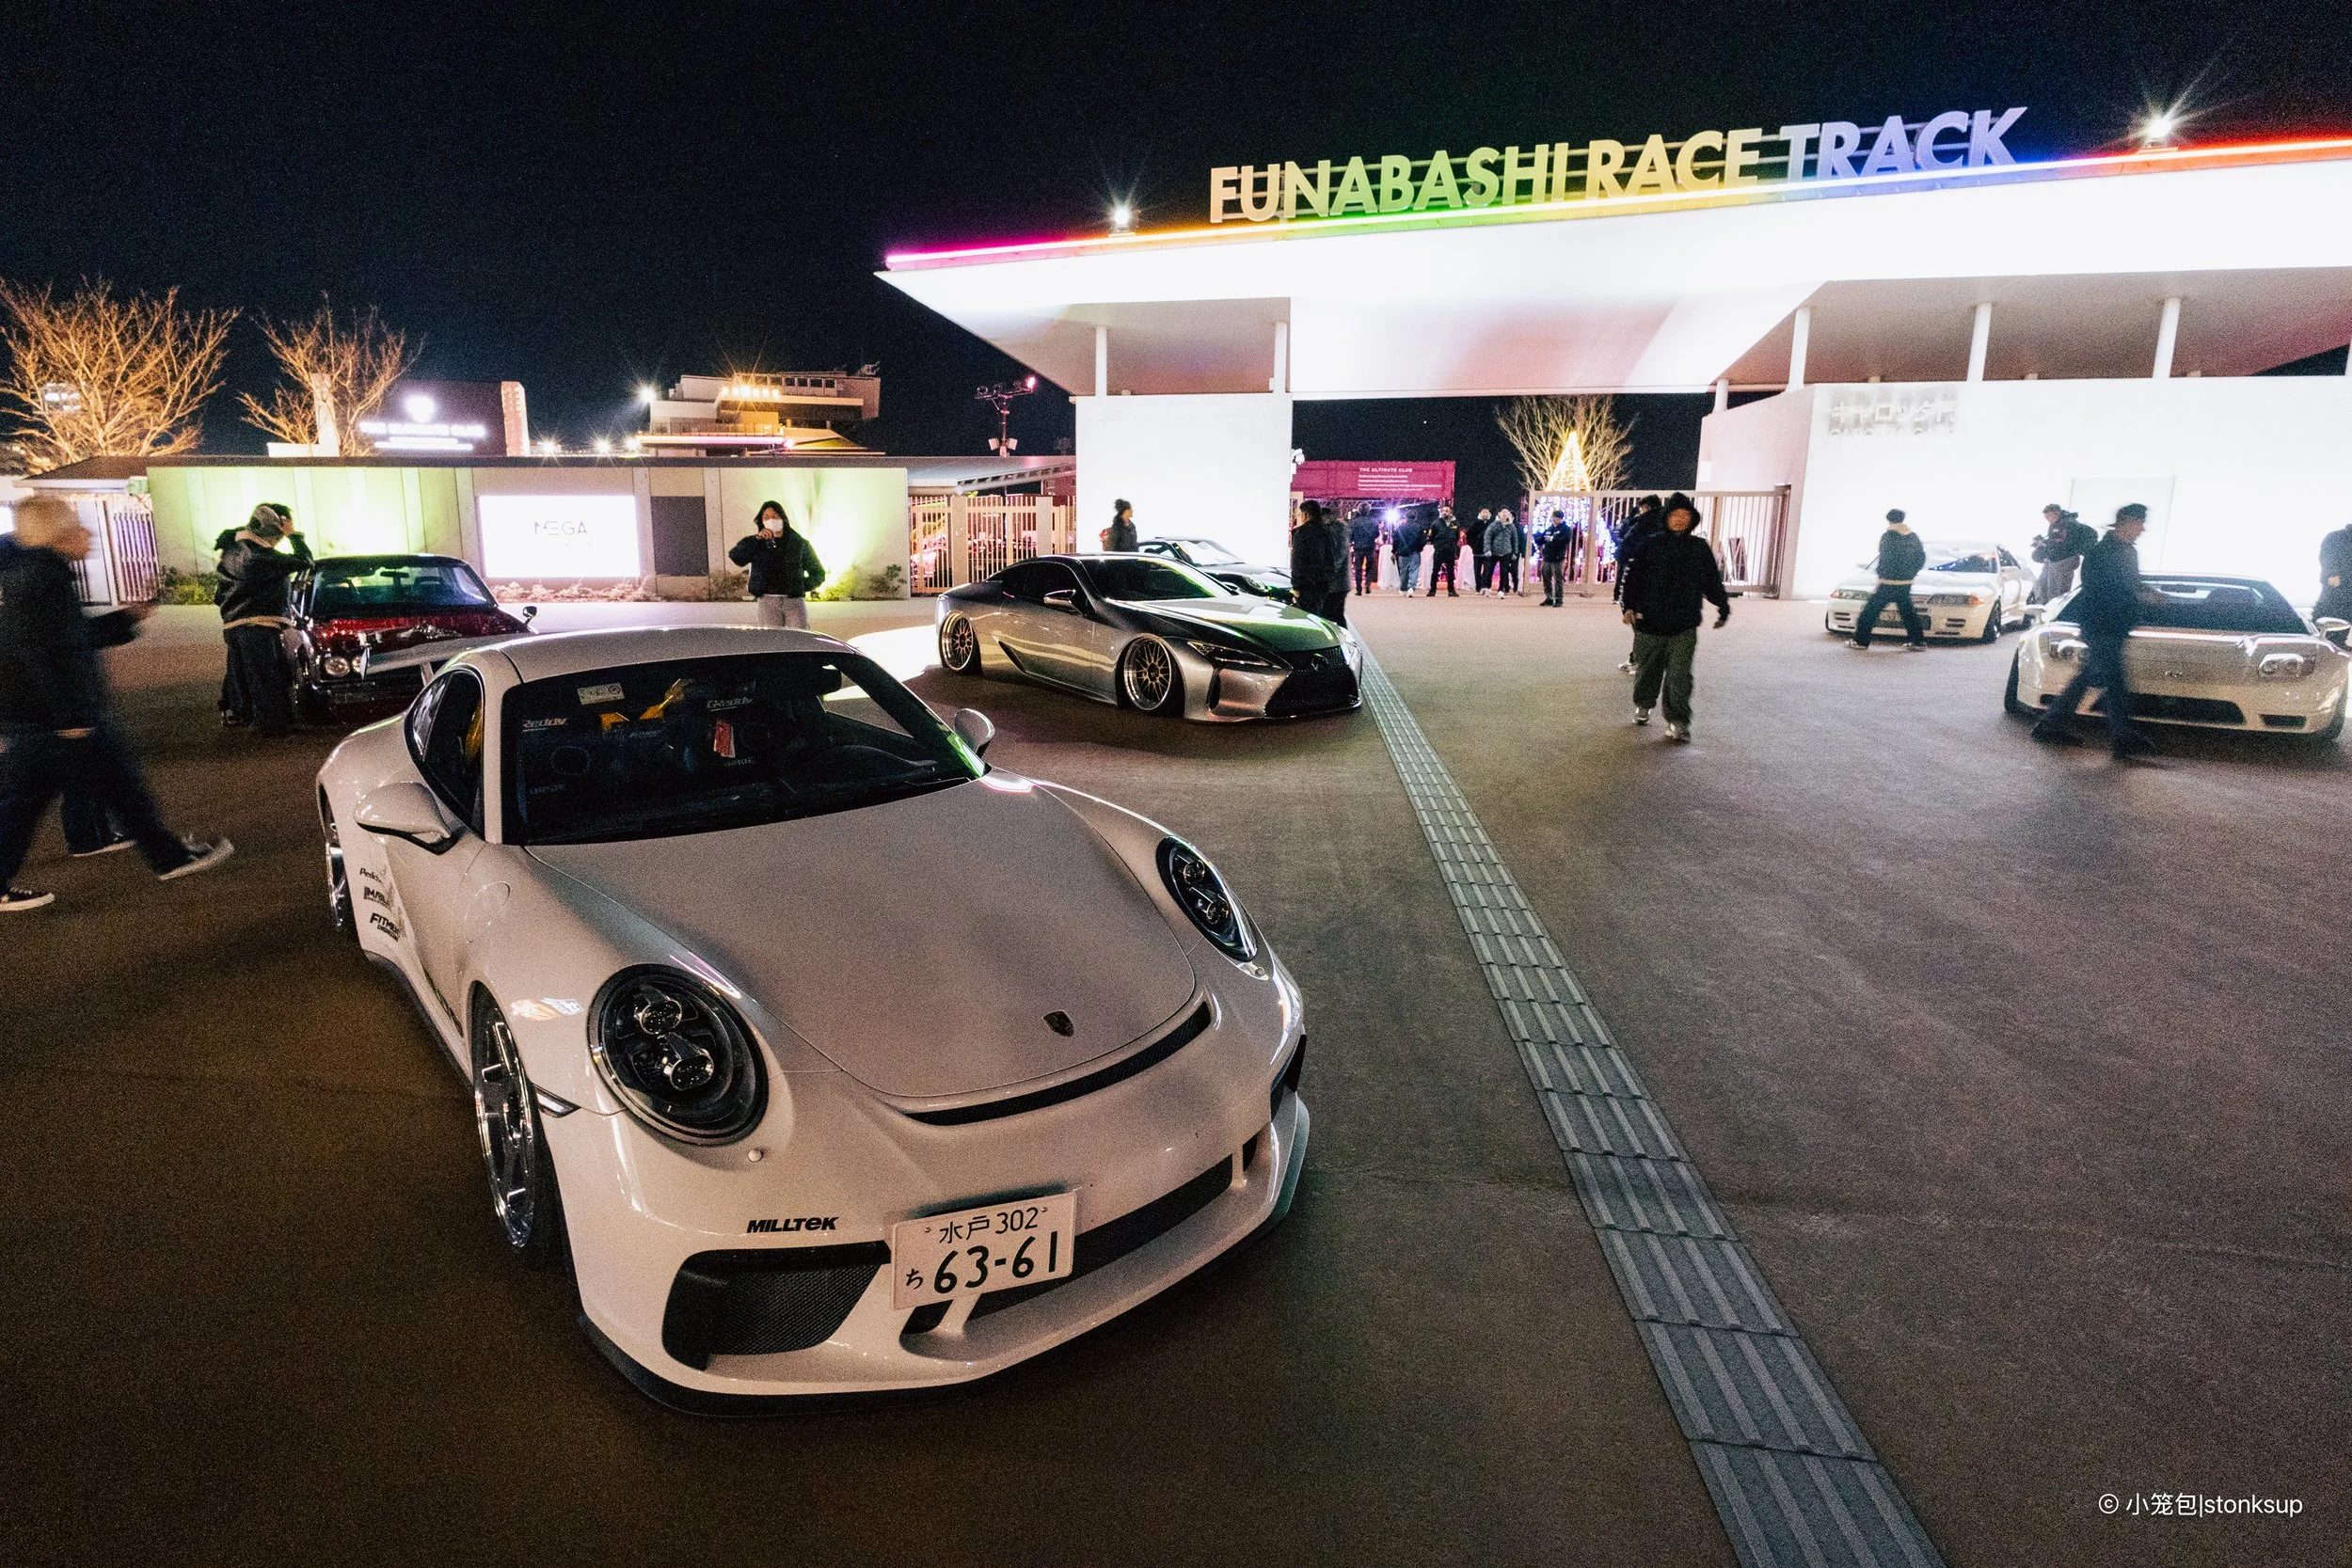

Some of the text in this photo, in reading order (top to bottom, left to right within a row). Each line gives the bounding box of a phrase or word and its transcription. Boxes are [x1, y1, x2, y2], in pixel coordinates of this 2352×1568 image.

[1210, 106, 2028, 223] FUNABASHI RACE TRACK
[939, 1207, 1039, 1243] 水戸 302
[906, 1231, 1058, 1294] ち 63-61
